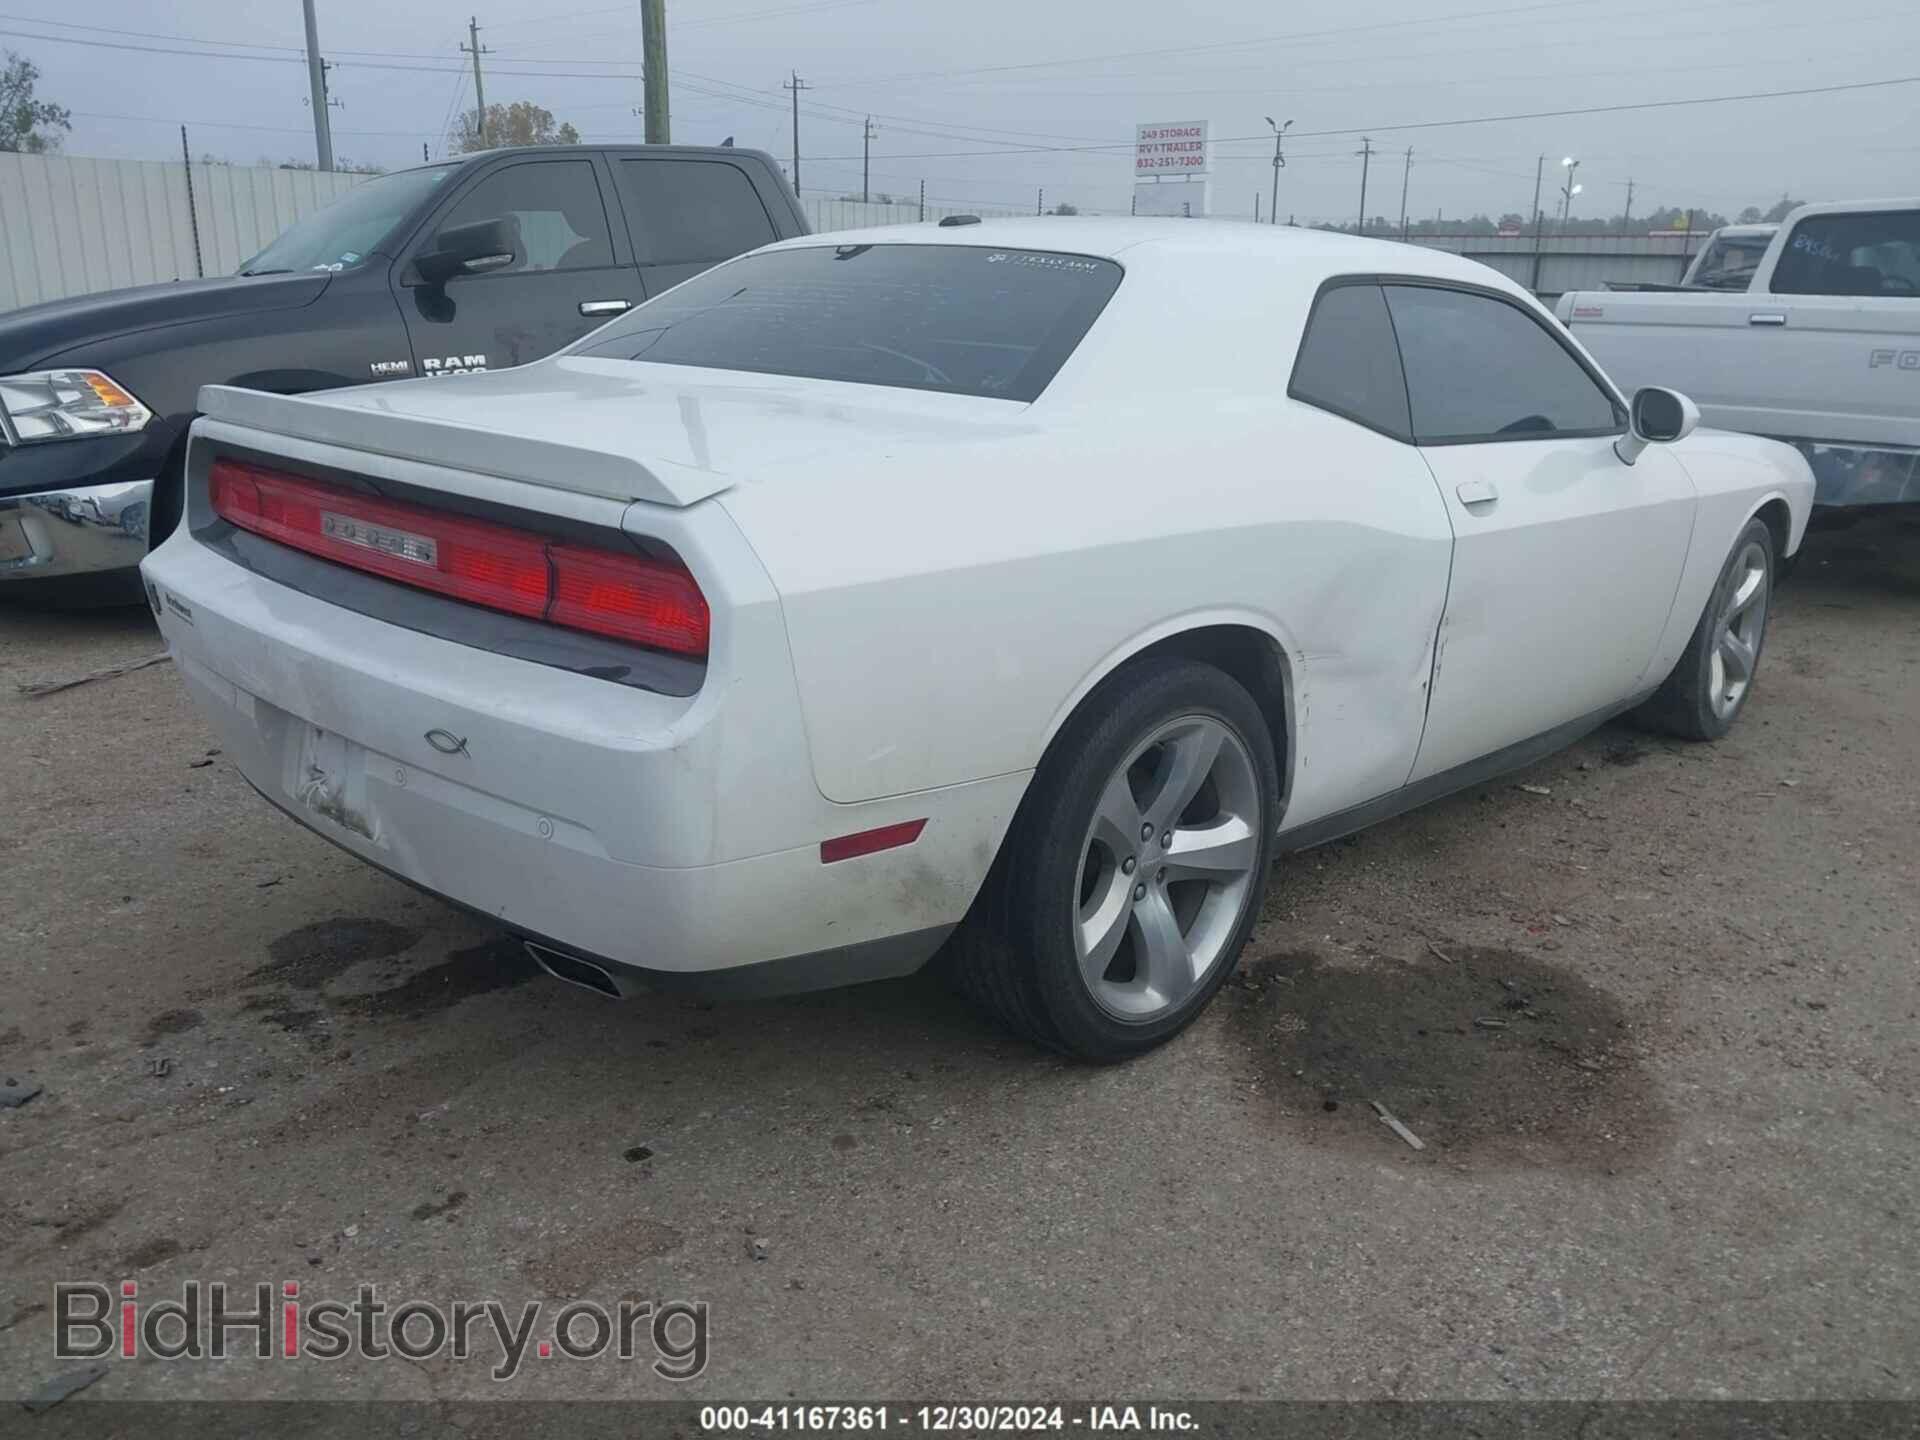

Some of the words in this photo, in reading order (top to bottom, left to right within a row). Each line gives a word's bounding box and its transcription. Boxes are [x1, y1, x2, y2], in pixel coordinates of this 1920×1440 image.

[1141, 130, 1157, 140] 249
[1159, 127, 1201, 139] STORAGE
[1139, 143, 1153, 153] RV
[1161, 141, 1202, 152] TRAILER
[371, 361, 408, 371] HEMI
[423, 354, 486, 370] RAM
